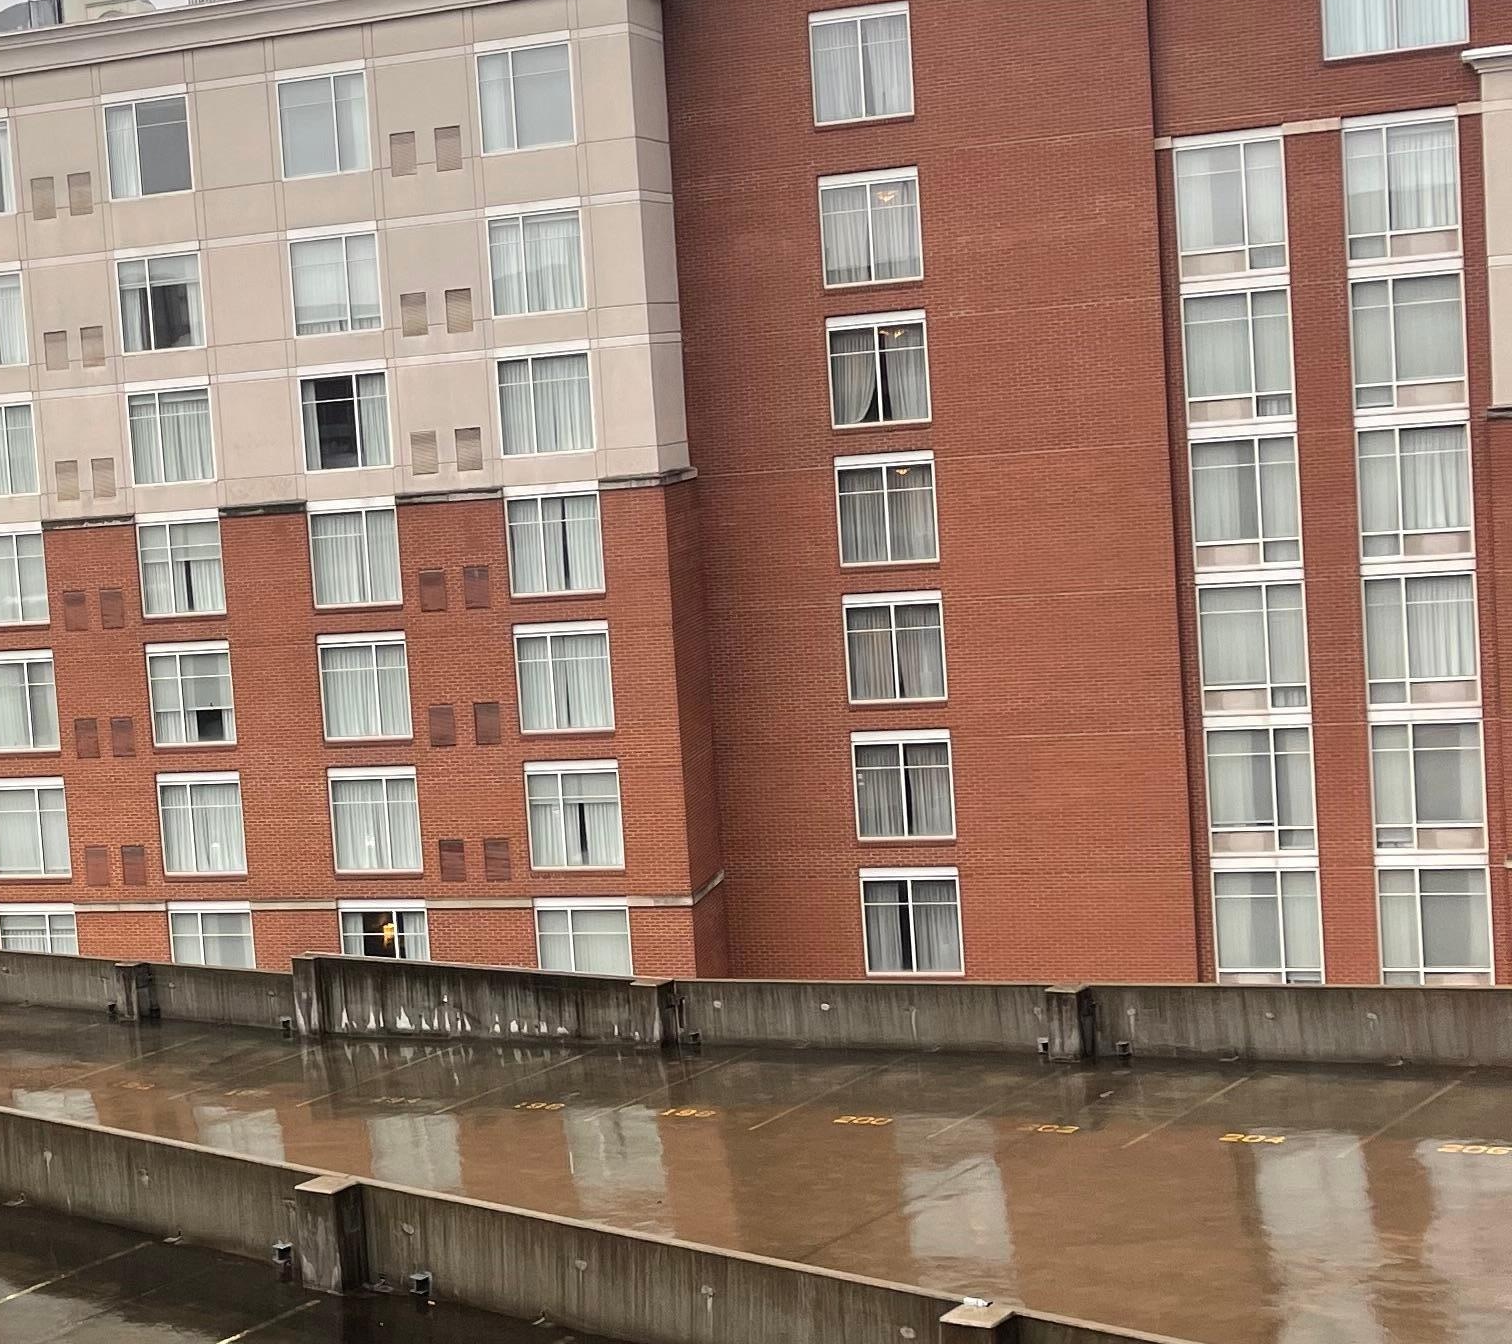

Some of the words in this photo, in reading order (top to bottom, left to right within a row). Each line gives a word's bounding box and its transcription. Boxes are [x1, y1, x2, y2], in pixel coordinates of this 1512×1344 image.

[833, 1115, 893, 1126] 200
[1219, 1133, 1286, 1144] 204
[1437, 1143, 1512, 1155] 206
